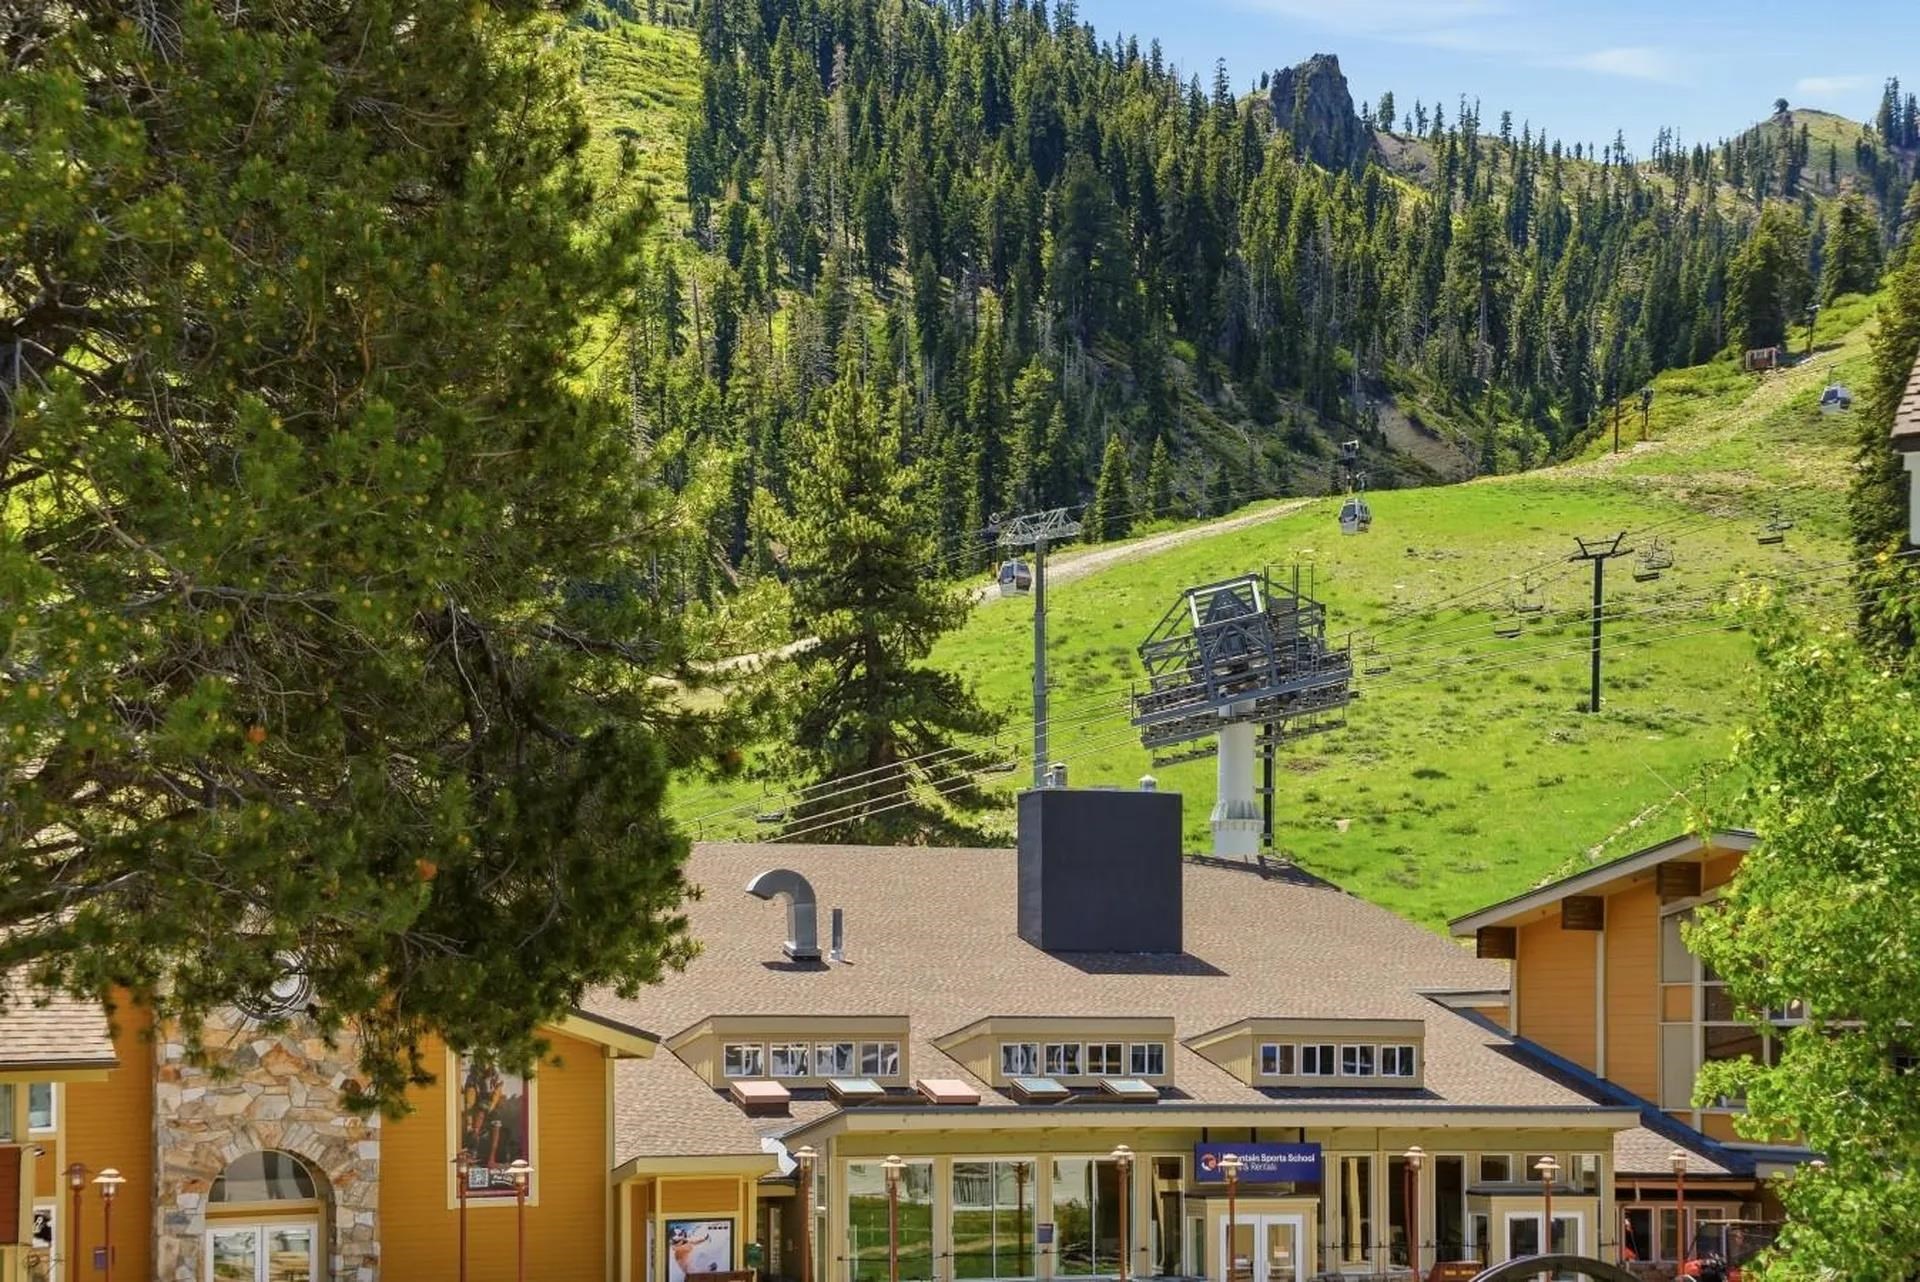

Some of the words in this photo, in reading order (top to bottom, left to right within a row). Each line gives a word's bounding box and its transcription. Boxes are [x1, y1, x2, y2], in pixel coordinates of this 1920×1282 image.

[1261, 1153, 1286, 1163] Sports
[1288, 1153, 1315, 1162] School
[1251, 1162, 1278, 1171] Rentals
